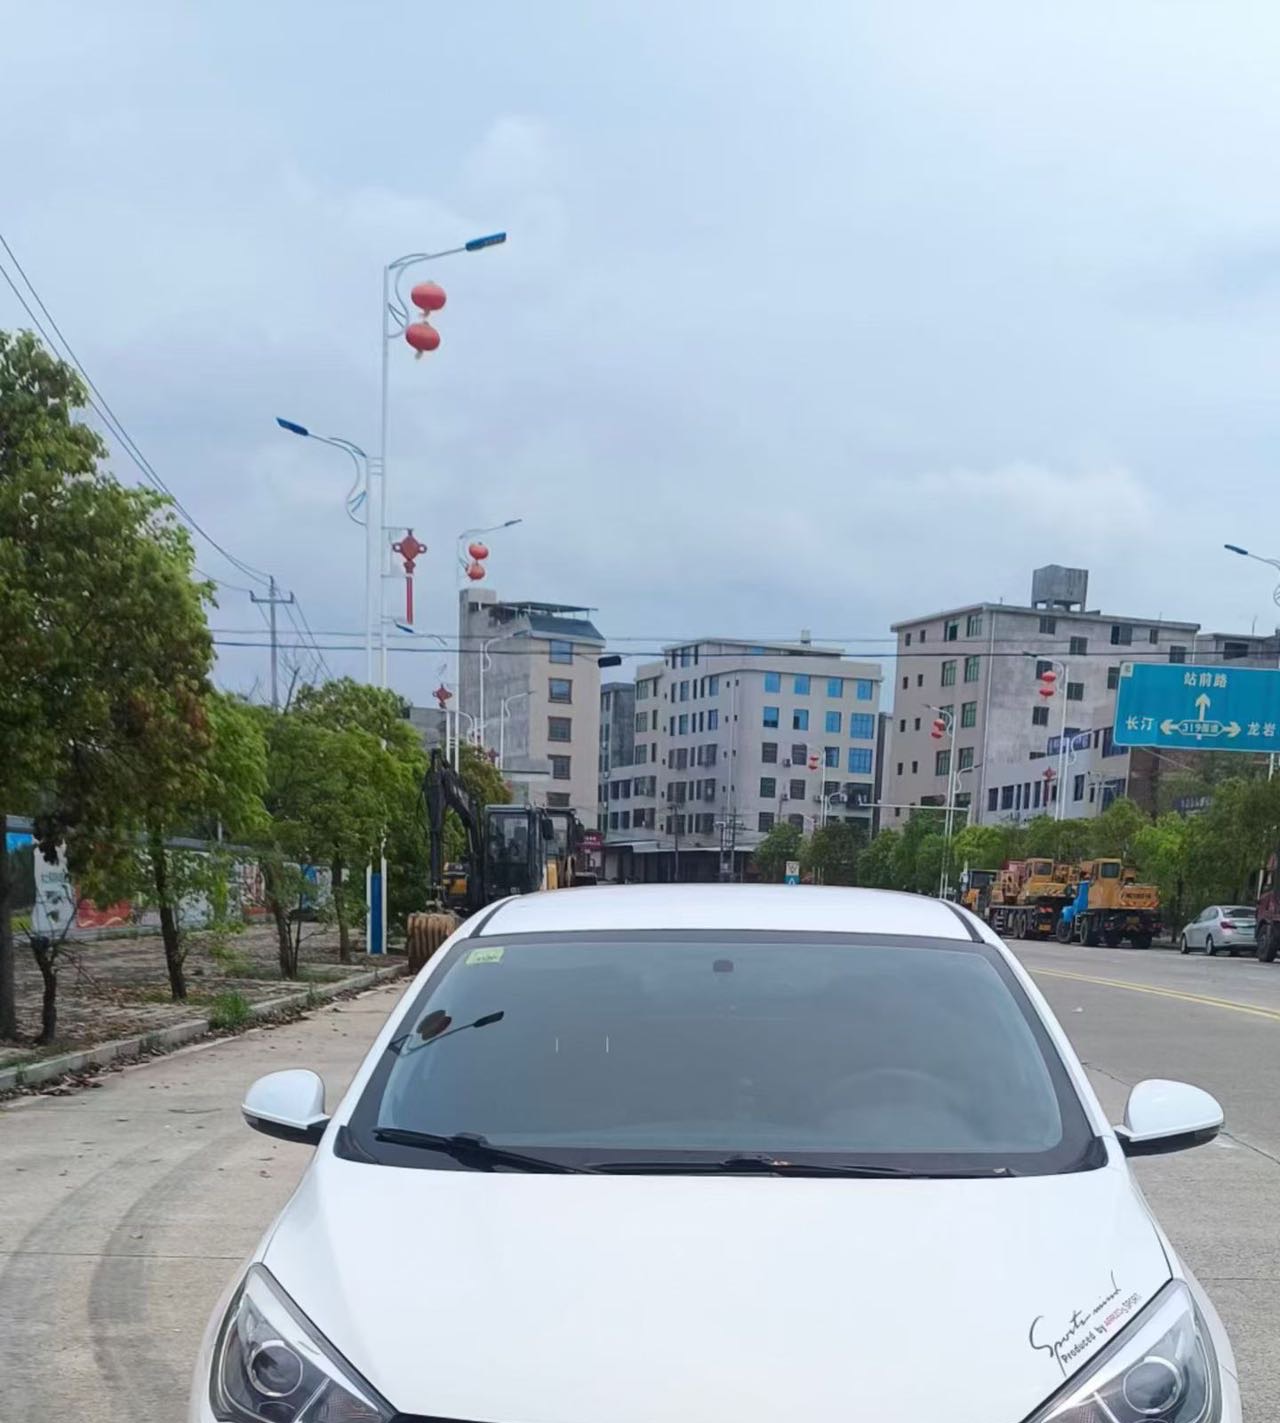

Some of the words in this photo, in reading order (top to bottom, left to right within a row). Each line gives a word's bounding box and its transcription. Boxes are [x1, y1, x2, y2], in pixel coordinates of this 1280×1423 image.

[1183, 672, 1228, 688] 站前路
[1126, 715, 1154, 731] 长汀
[1247, 722, 1276, 737] 龙岩
[1061, 1332, 1095, 1364] Produced
[1094, 1325, 1108, 1334] by
